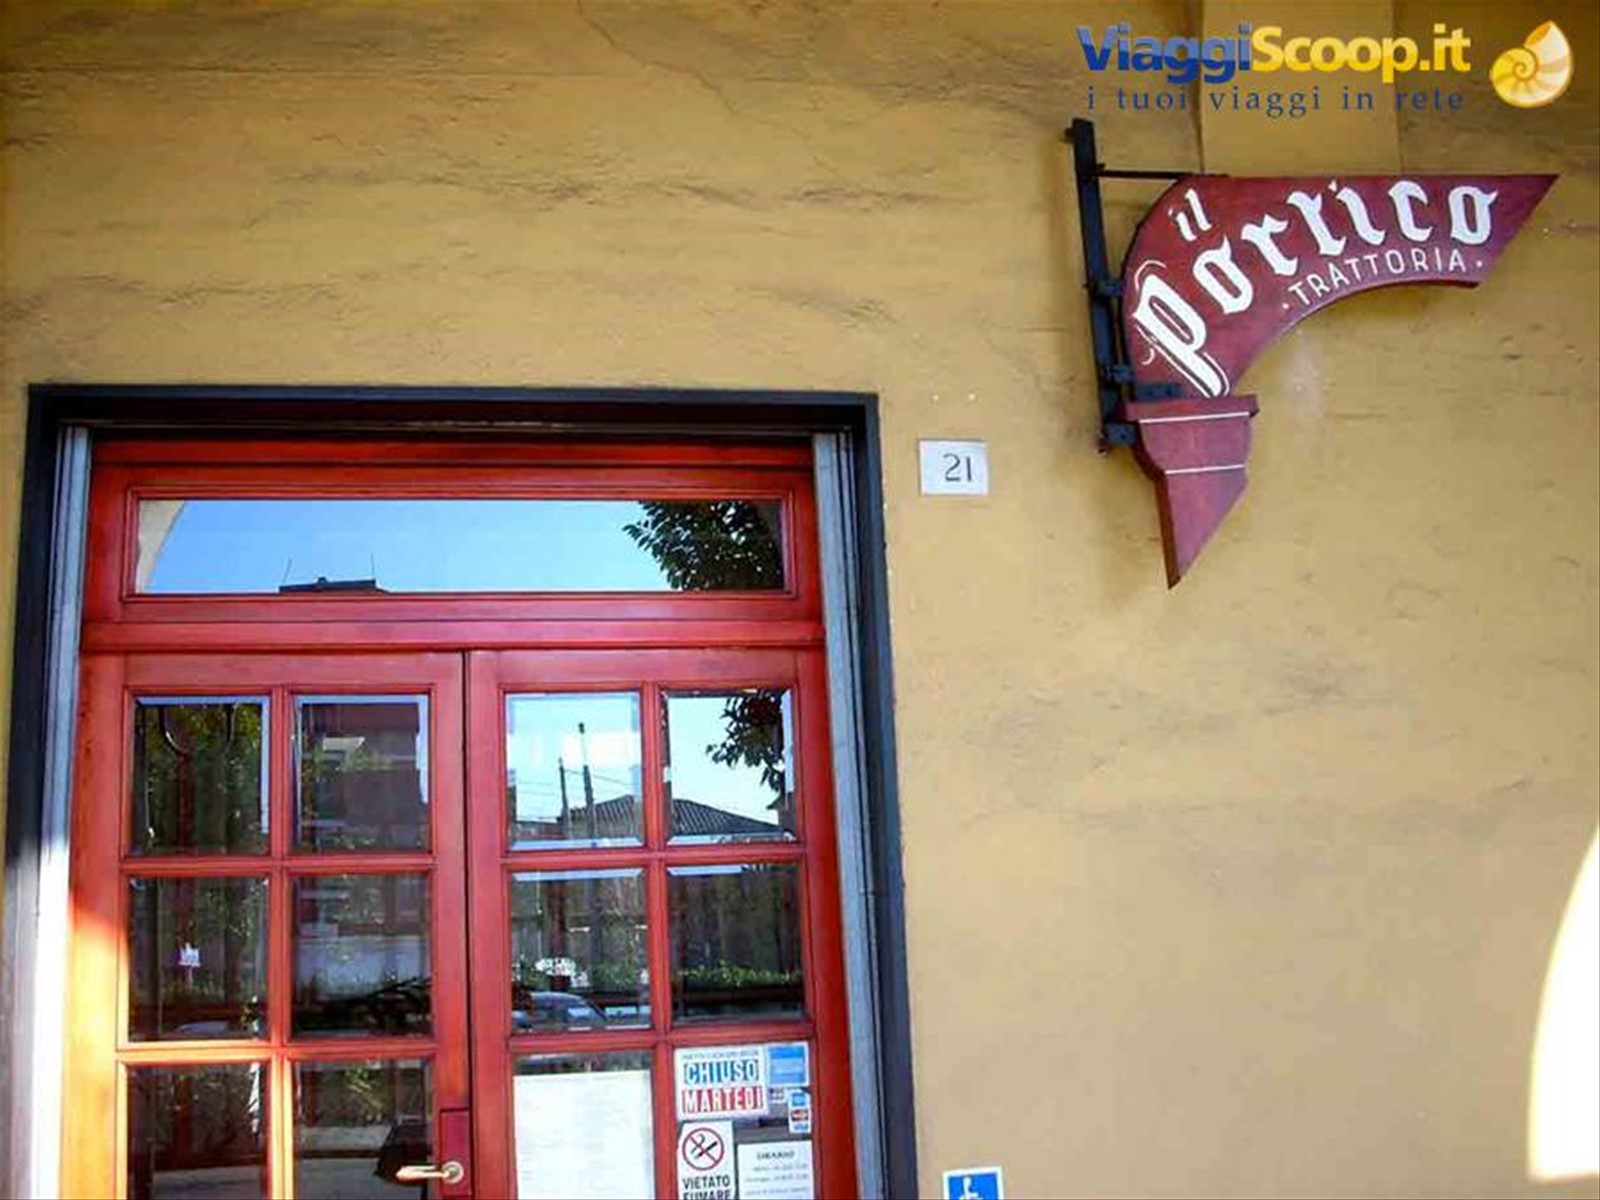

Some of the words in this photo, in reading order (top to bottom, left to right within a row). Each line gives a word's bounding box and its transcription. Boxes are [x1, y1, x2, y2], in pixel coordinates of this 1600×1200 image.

[943, 453, 972, 482] 21
[684, 1059, 759, 1084] CHIUSO
[682, 1175, 730, 1190] VIETATO
